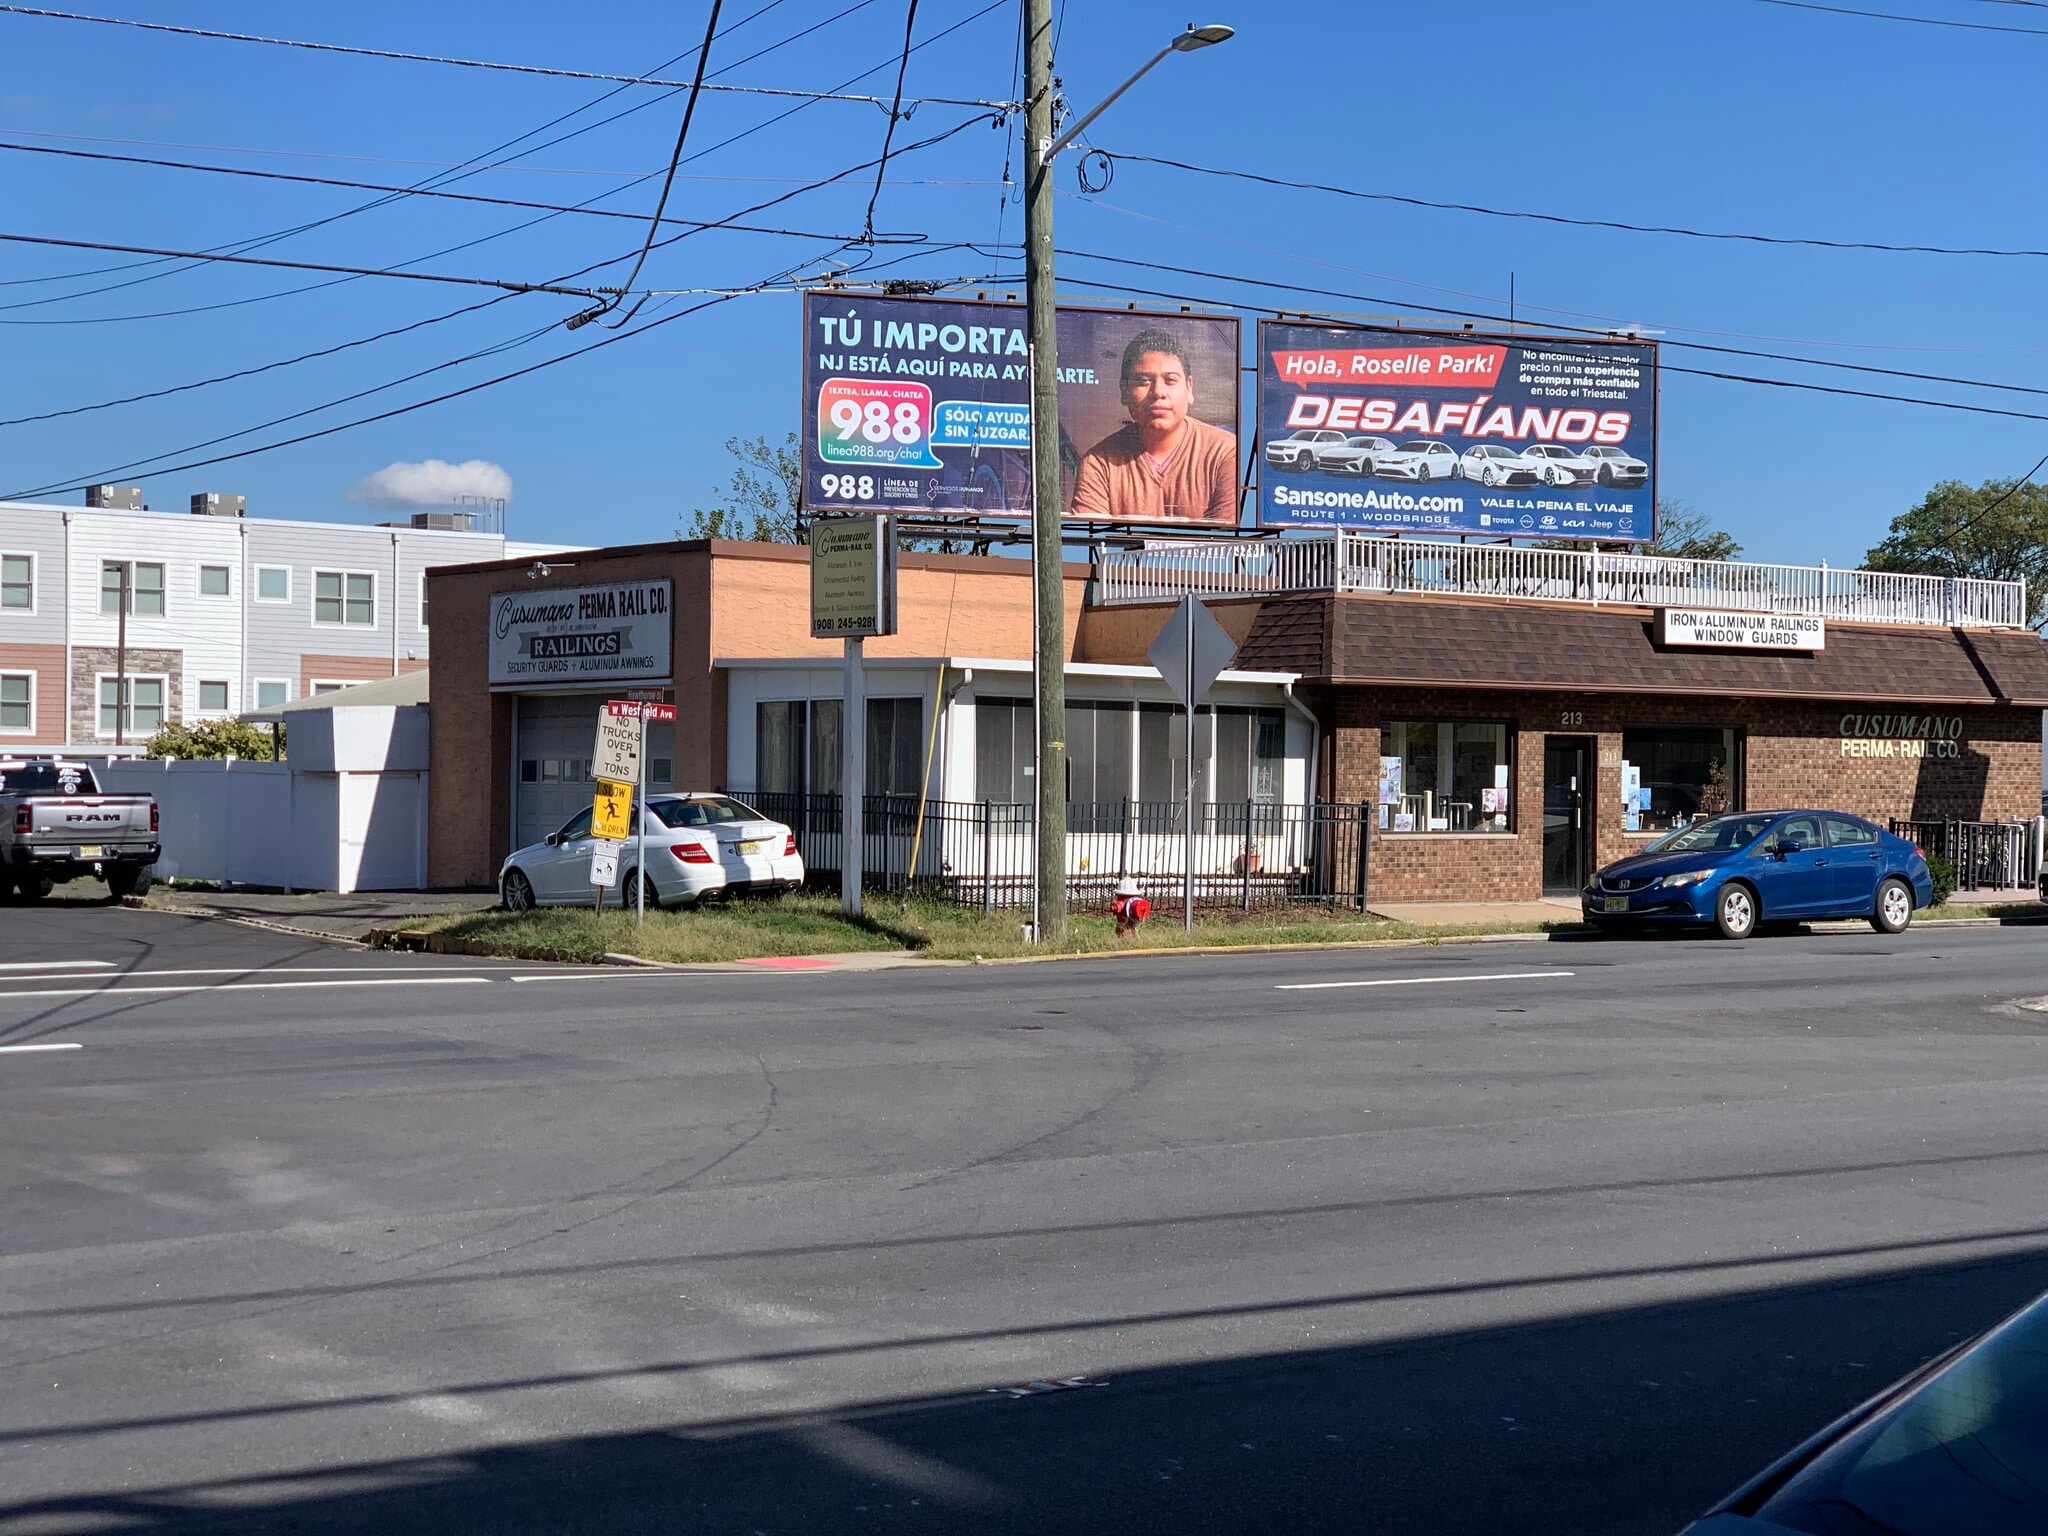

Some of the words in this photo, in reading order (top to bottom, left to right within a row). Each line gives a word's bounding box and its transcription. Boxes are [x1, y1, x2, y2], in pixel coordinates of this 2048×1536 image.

[819, 309, 862, 347] TÚ
[1522, 350, 1537, 360] No
[819, 353, 844, 371] NJ
[849, 352, 892, 374] ESTÁ
[895, 355, 945, 377] AQUÍ
[949, 361, 998, 380] PARA
[1001, 364, 1100, 385] AYARTE.
[1285, 354, 1343, 378] Hola,
[1350, 353, 1431, 375] Roselle
[1437, 352, 1495, 374] Park!
[1520, 363, 1551, 373] precio
[1553, 363, 1562, 373] ni
[1564, 365, 1582, 374] una
[1584, 366, 1640, 377] experiencia
[1519, 373, 1532, 383] de
[1534, 376, 1571, 386] compra
[1573, 376, 1594, 387] más
[1595, 378, 1640, 389] confiable
[828, 386, 860, 397] TEXTEA,
[860, 389, 892, 399] LLAMA,
[892, 390, 924, 400] CHATEA
[1531, 387, 1543, 395] en
[1545, 387, 1568, 396] todo
[1570, 388, 1580, 397] el
[1582, 388, 1629, 400] Triestatal.
[830, 398, 921, 444] 988
[945, 405, 983, 423] SÓLO
[1286, 395, 1632, 444] DESAFÍANOS
[944, 425, 969, 438] SIN
[827, 442, 923, 461] linea988.org/chat
[820, 473, 874, 500] 988
[883, 477, 907, 487] LÍNEA
[908, 480, 919, 488] DE
[1274, 485, 1464, 513] SansoneAuto.com
[1480, 497, 1515, 508] VALE
[1516, 499, 1535, 509] LA
[1536, 501, 1574, 511] PENA
[1575, 502, 1592, 512] EL
[1594, 503, 1634, 513] VIAJE
[1291, 509, 1335, 519] ROUTE
[1340, 511, 1346, 520] 1
[1362, 512, 1451, 524] WOODBRIDGE
[1492, 516, 1515, 525] TOYOTA
[1589, 519, 1614, 530] Jeep
[816, 526, 870, 558] Cusumano
[830, 543, 863, 553] PERMA-RAIL
[864, 542, 874, 551] CO.
[495, 596, 575, 640] Cusumano
[579, 591, 617, 620] PERMA
[619, 588, 648, 617] RAIL
[649, 587, 668, 615] CO.
[813, 618, 835, 631] (908)
[837, 616, 876, 629] 245-9281
[1670, 612, 1697, 627] IRON
[1705, 614, 1766, 630] ALUMINUM
[1771, 617, 1819, 632] RAILINGS
[1694, 628, 1745, 643] WINDOW
[1752, 631, 1798, 645] GUARDS
[533, 634, 618, 656] RAILINGS
[507, 660, 537, 674] SECURITY
[538, 659, 569, 673] GUARDS
[579, 656, 620, 672] ALUMINUM
[620, 655, 654, 670] AWNINGS
[621, 703, 658, 718] Westield
[659, 709, 673, 719] Ave
[1561, 711, 1583, 725] 213
[615, 716, 630, 728] NO
[1839, 713, 1963, 739] CUSUMANO
[602, 725, 641, 742] TRUCKS
[606, 738, 633, 752] OVER
[1841, 739, 1934, 758] PERMA-RAIL
[1936, 740, 1961, 759] CO.
[615, 752, 622, 762] 5
[1604, 751, 1618, 761] 213
[604, 762, 630, 776] TONS
[602, 784, 626, 799] SLOW
[65, 814, 121, 822] RAM
